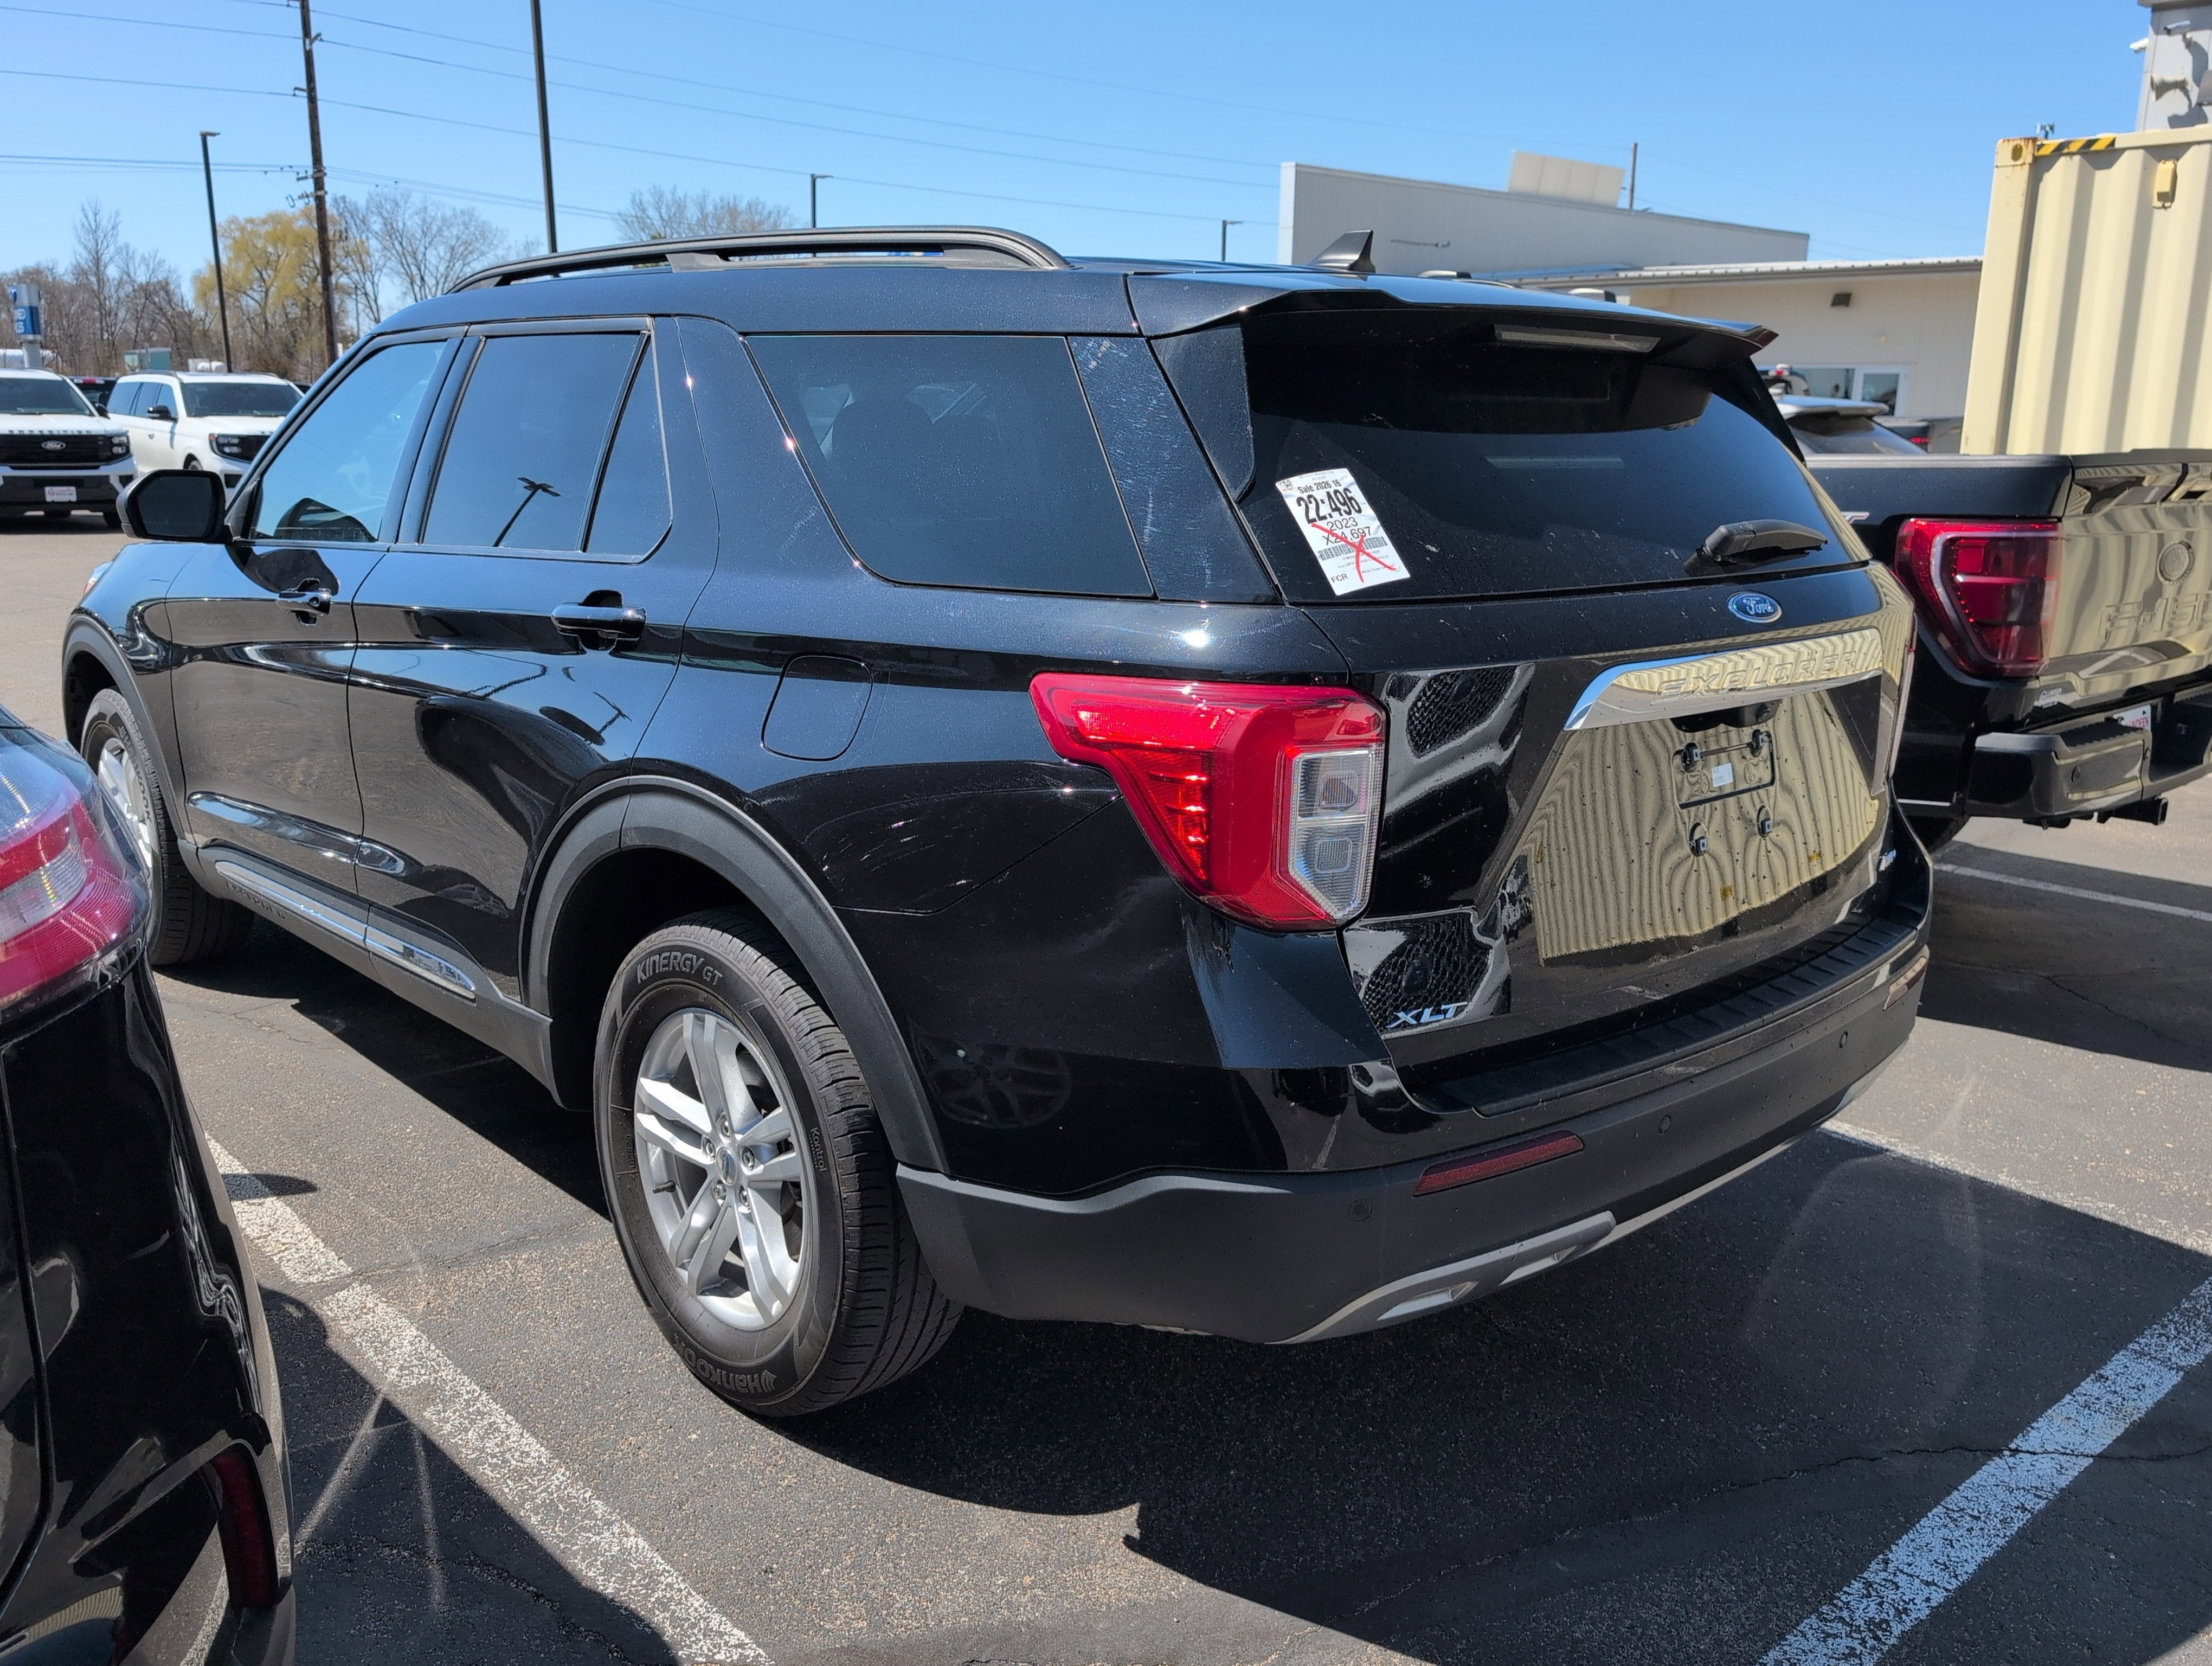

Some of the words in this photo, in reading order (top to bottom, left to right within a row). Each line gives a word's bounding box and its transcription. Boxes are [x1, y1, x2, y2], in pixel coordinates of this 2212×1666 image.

[1297, 485, 1314, 494] Sale
[1314, 481, 1332, 490] 2026
[1327, 517, 1358, 531] 2023
[1331, 573, 1348, 583] FCR
[1651, 650, 1856, 705] EXPLORER
[702, 966, 723, 985] GT
[1385, 1002, 1468, 1029] XLT
[811, 1127, 827, 1171] Kontrol
